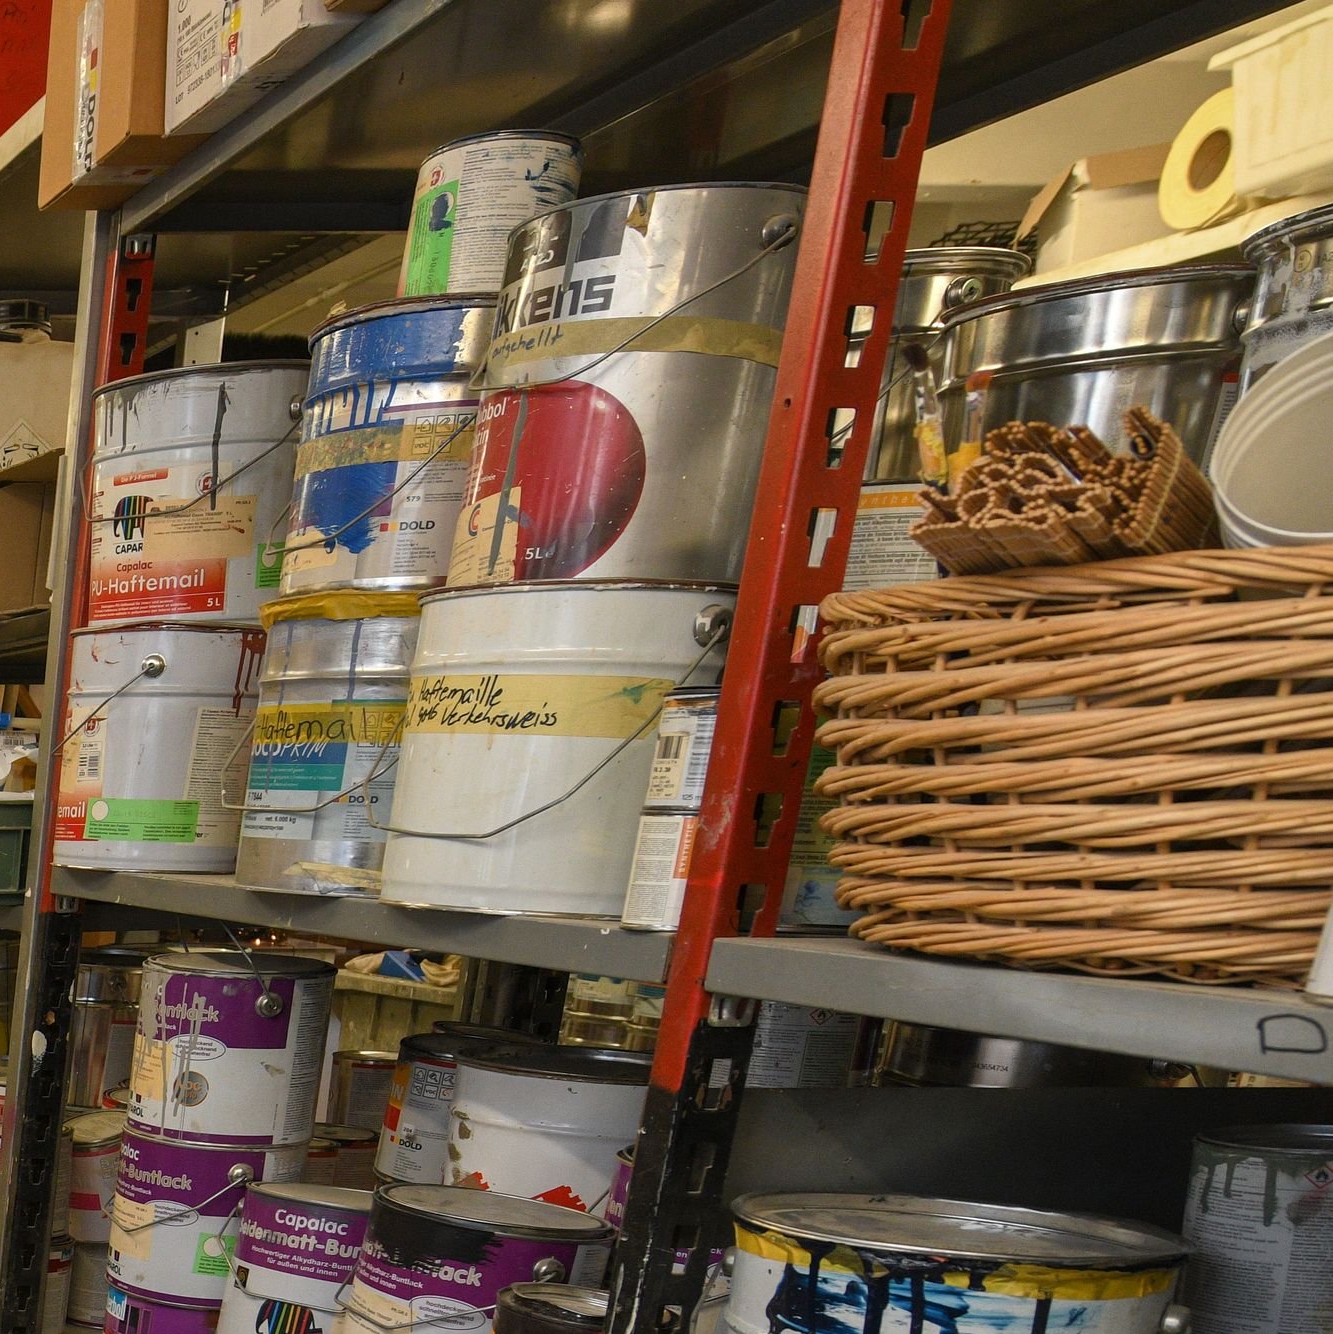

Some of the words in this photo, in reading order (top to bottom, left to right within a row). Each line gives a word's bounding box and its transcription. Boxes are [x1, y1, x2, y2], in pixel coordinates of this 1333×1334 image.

[399, 520, 436, 532] DOLD
[116, 560, 153, 574] Capalac
[91, 567, 205, 597] PU-Haftemail
[206, 597, 214, 608] 5
[214, 596, 221, 607] L
[440, 701, 558, 730] Verkehrsweiss
[348, 795, 379, 804] DOD
[1256, 1013, 1329, 1055] D
[398, 1138, 423, 1151] DOLD
[274, 1208, 349, 1236] Capalac
